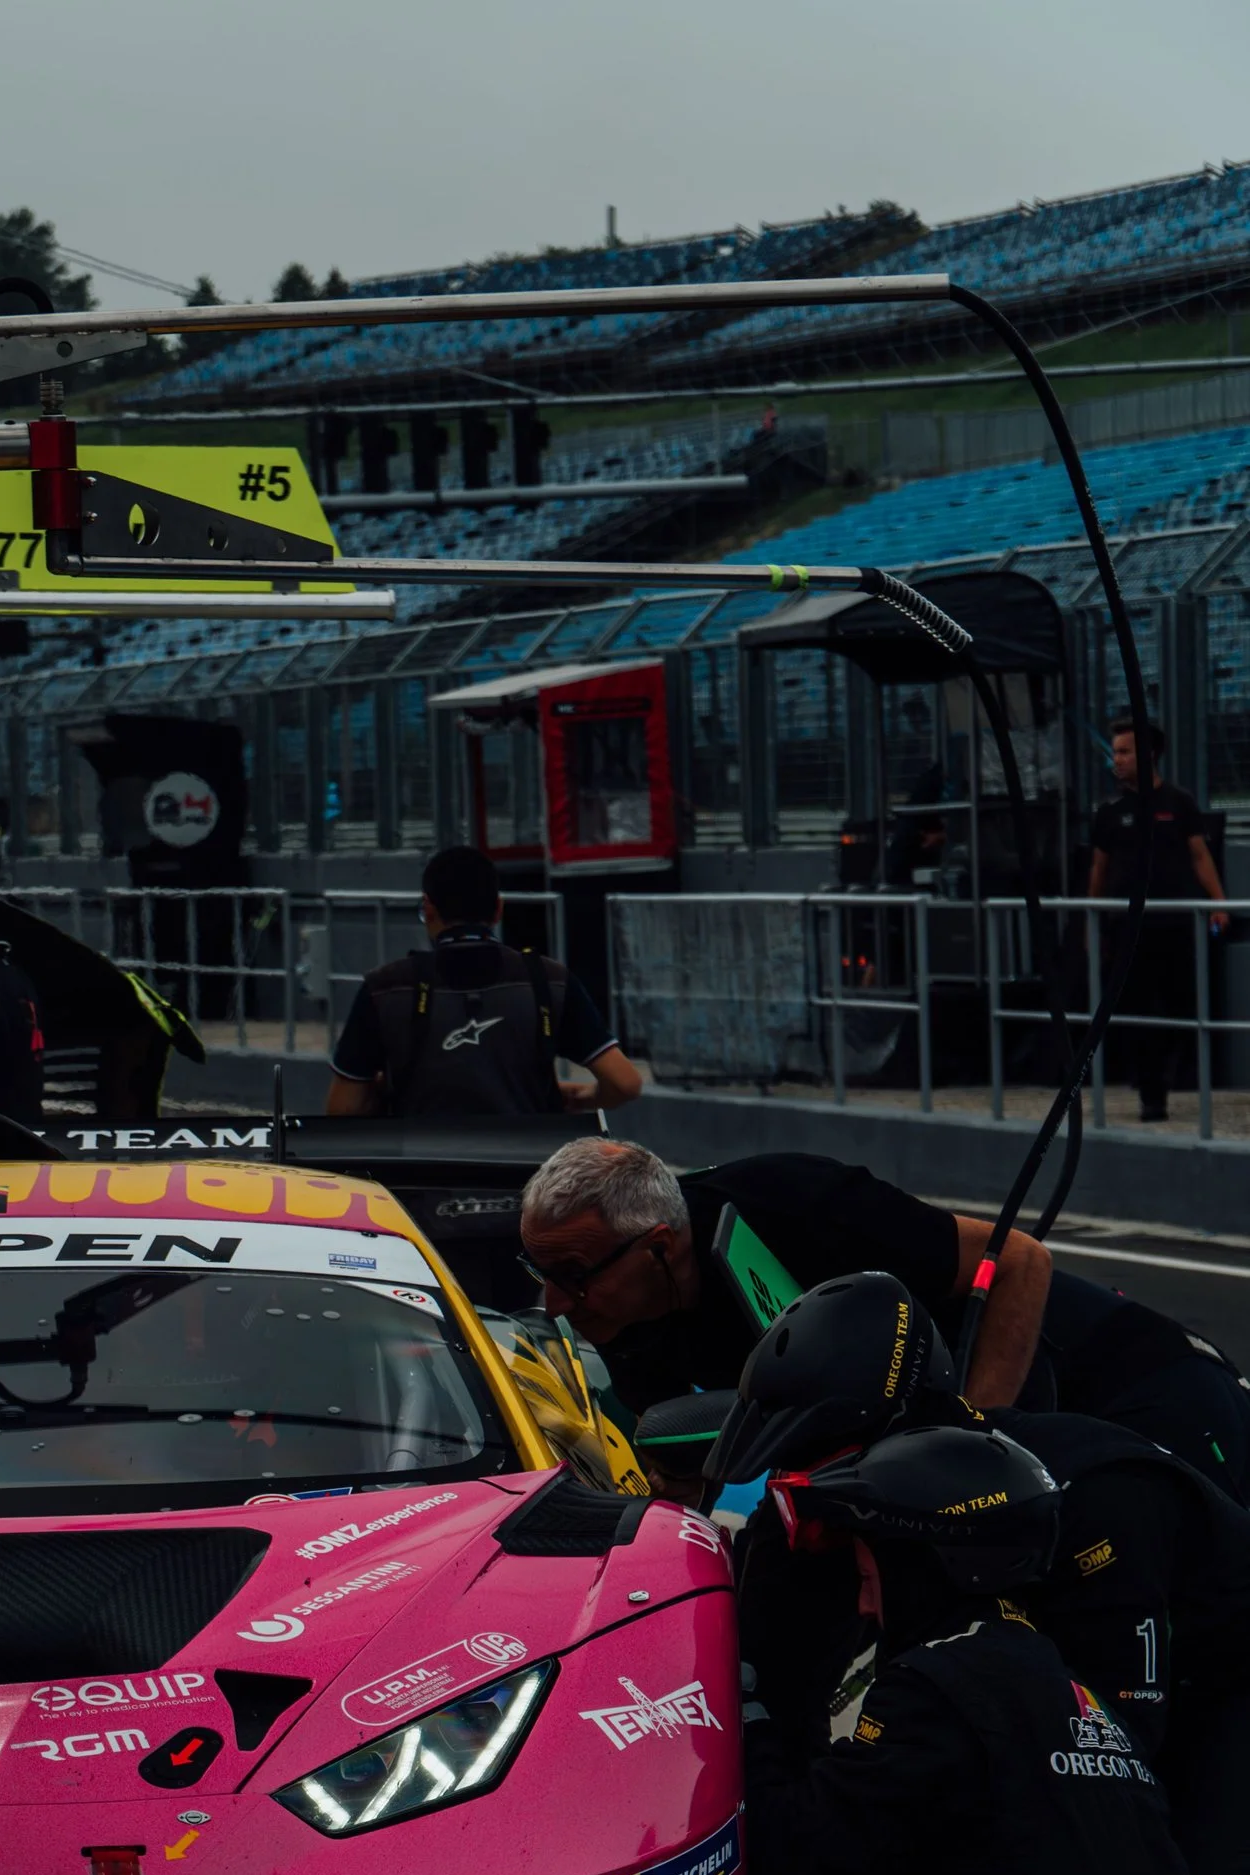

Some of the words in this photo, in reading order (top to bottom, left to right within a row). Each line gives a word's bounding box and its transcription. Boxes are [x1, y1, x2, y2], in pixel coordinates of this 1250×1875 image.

[239, 464, 291, 501] #5
[67, 1127, 271, 1149] TEAM
[330, 1255, 375, 1264] FRIDAY
[884, 1338, 906, 1398] OREGON
[897, 1301, 909, 1335] TEAM
[905, 1335, 926, 1397] UNIVET
[968, 1491, 1008, 1511] TEAM
[294, 1491, 458, 1560] #OMZexperience
[1078, 1543, 1113, 1572] OMP
[292, 1561, 407, 1616] SESSANTINI
[367, 1565, 423, 1592] IMPIANTI
[1135, 1617, 1157, 1684] 1
[363, 1667, 437, 1704] U.P.M.
[102, 1702, 150, 1713] medical
[153, 1696, 216, 1709] innovation
[11, 1728, 150, 1761] RGM
[1050, 1752, 1132, 1779] OREGON
